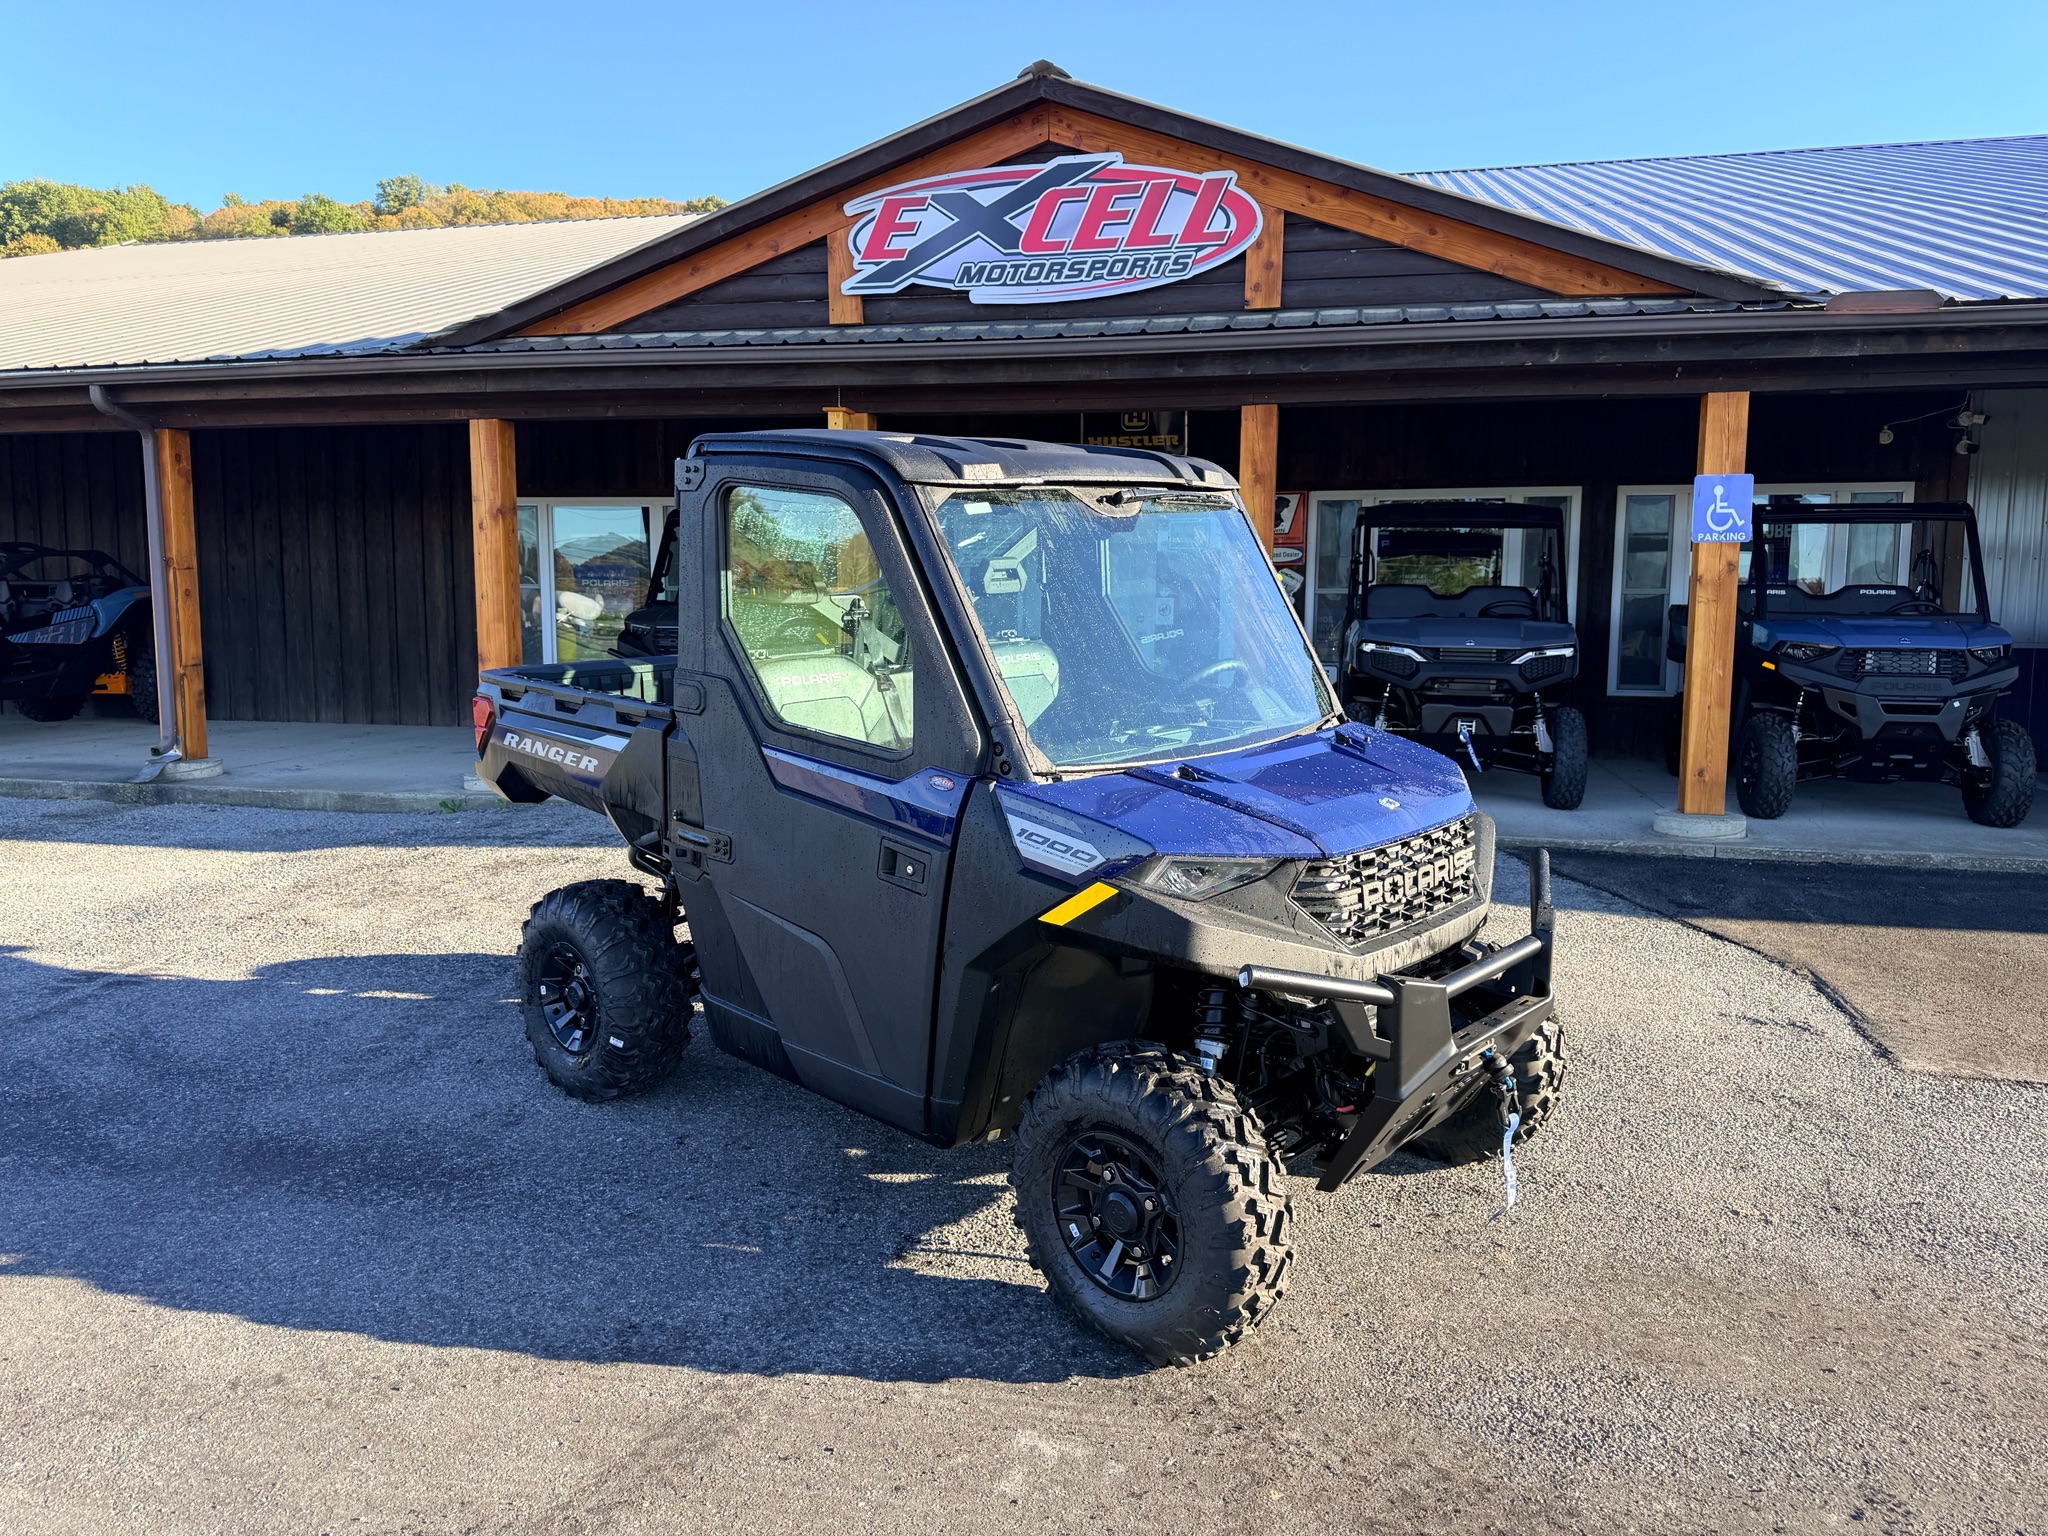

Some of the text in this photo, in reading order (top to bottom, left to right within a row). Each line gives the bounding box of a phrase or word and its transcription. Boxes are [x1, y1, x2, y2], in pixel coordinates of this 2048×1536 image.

[847, 160, 1232, 290] EXCELL
[955, 252, 1196, 287] MOTORSPORTS
[1087, 435, 1179, 447] HUSTLER
[1698, 532, 1746, 541] PARKING
[995, 652, 1042, 664] POLARIS
[780, 672, 842, 687] POLARIS
[1871, 682, 1943, 692] POLARIS
[502, 732, 599, 773] RANGER
[1015, 827, 1098, 864] 1000
[1361, 852, 1474, 910] POLARIS
